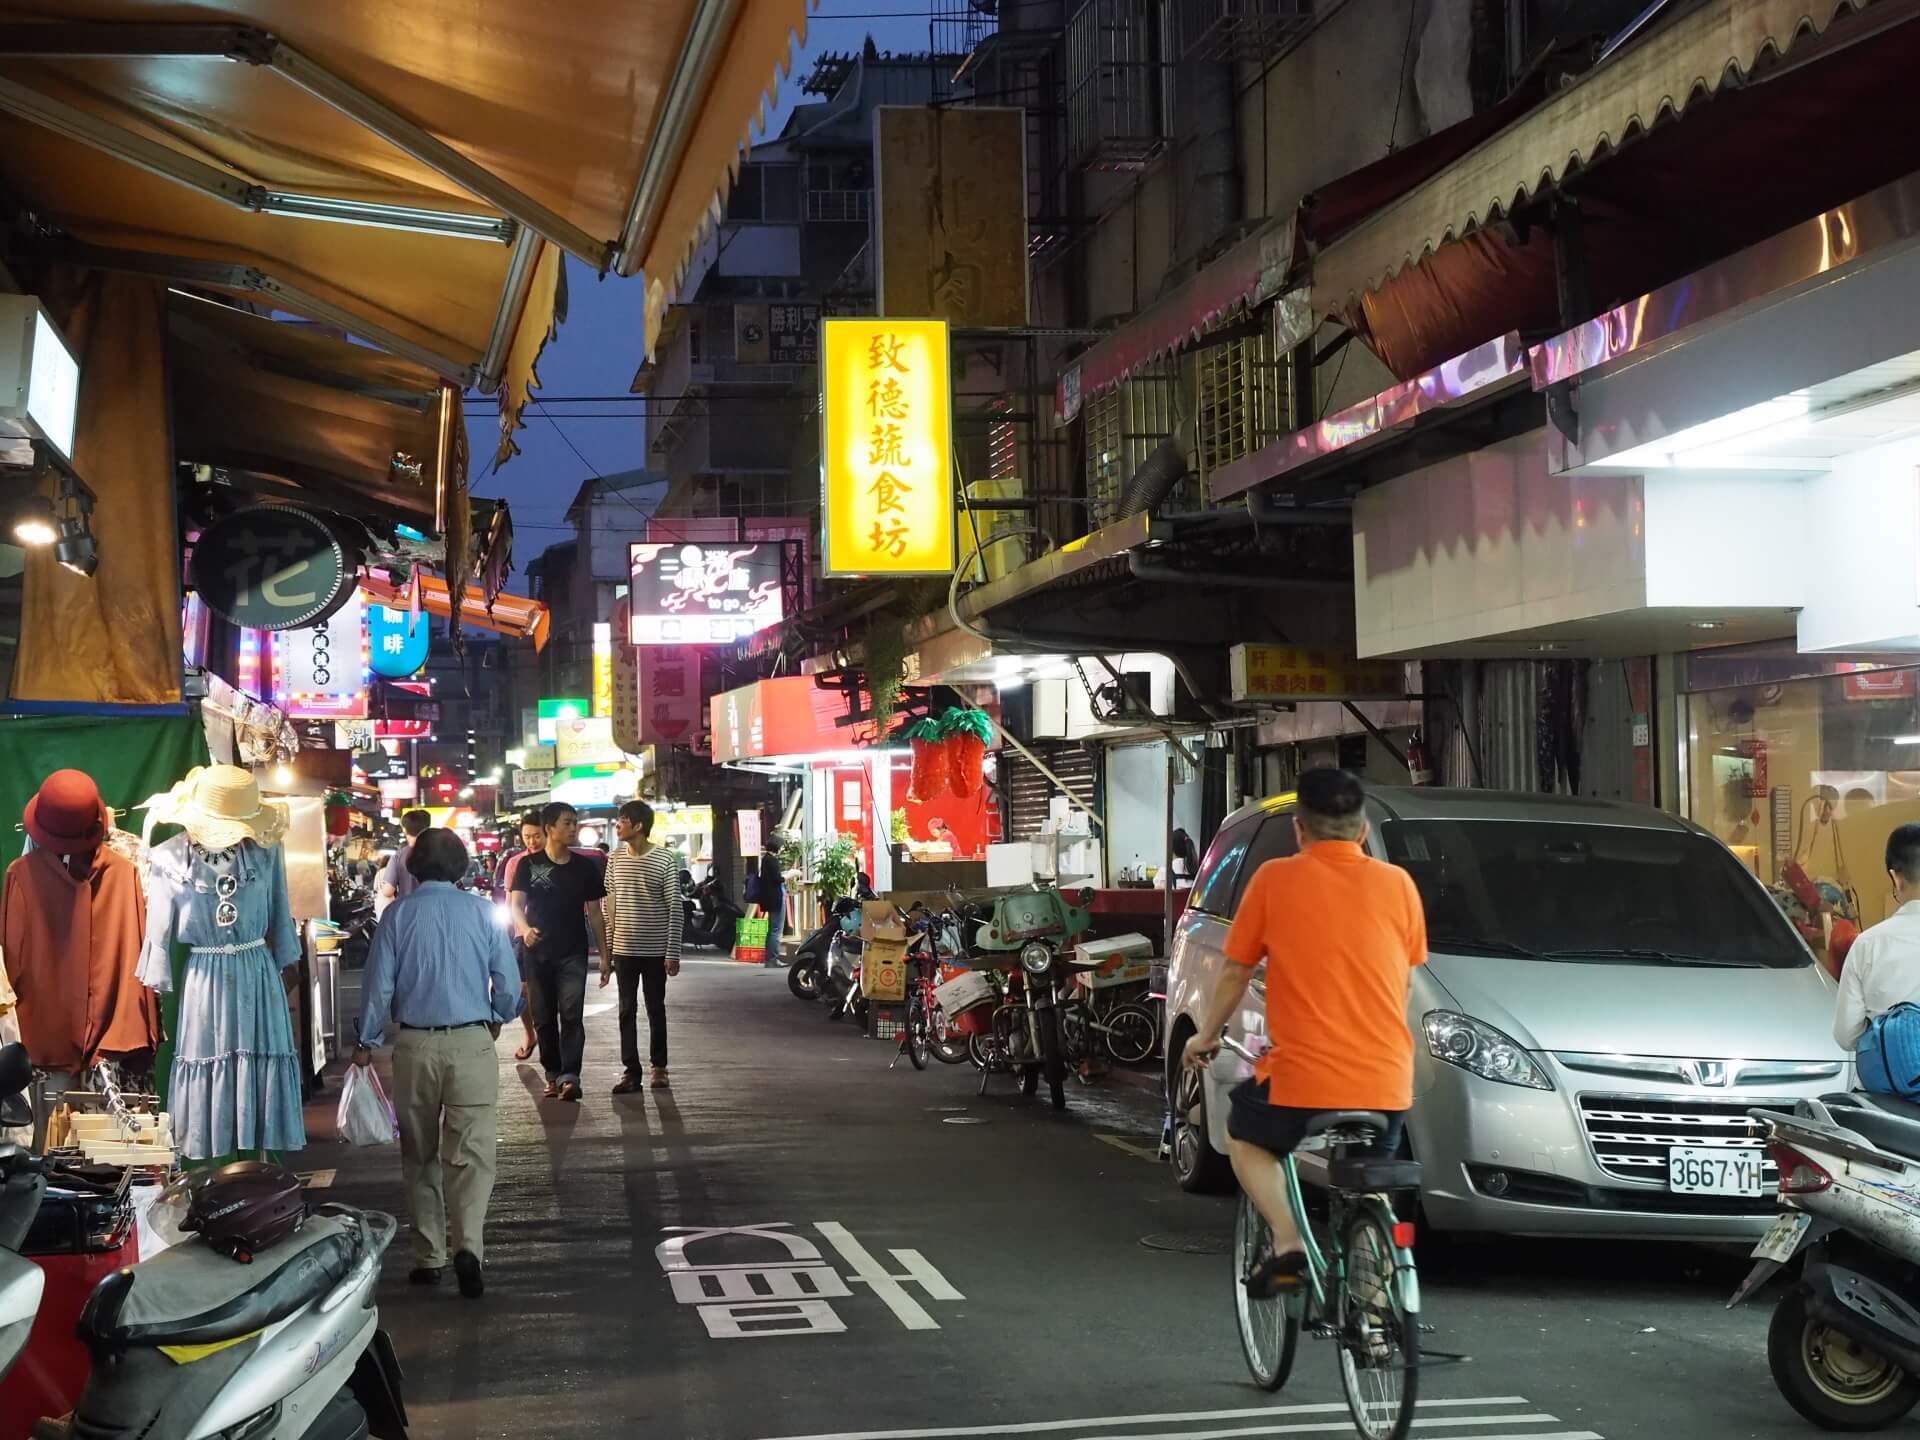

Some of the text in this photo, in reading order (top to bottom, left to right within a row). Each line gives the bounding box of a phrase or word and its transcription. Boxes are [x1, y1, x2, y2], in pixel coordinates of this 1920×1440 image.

[865, 332, 913, 559] 致德蔬食坊
[223, 528, 317, 607] 花
[383, 606, 404, 655] 咖啡
[708, 597, 740, 612] to go
